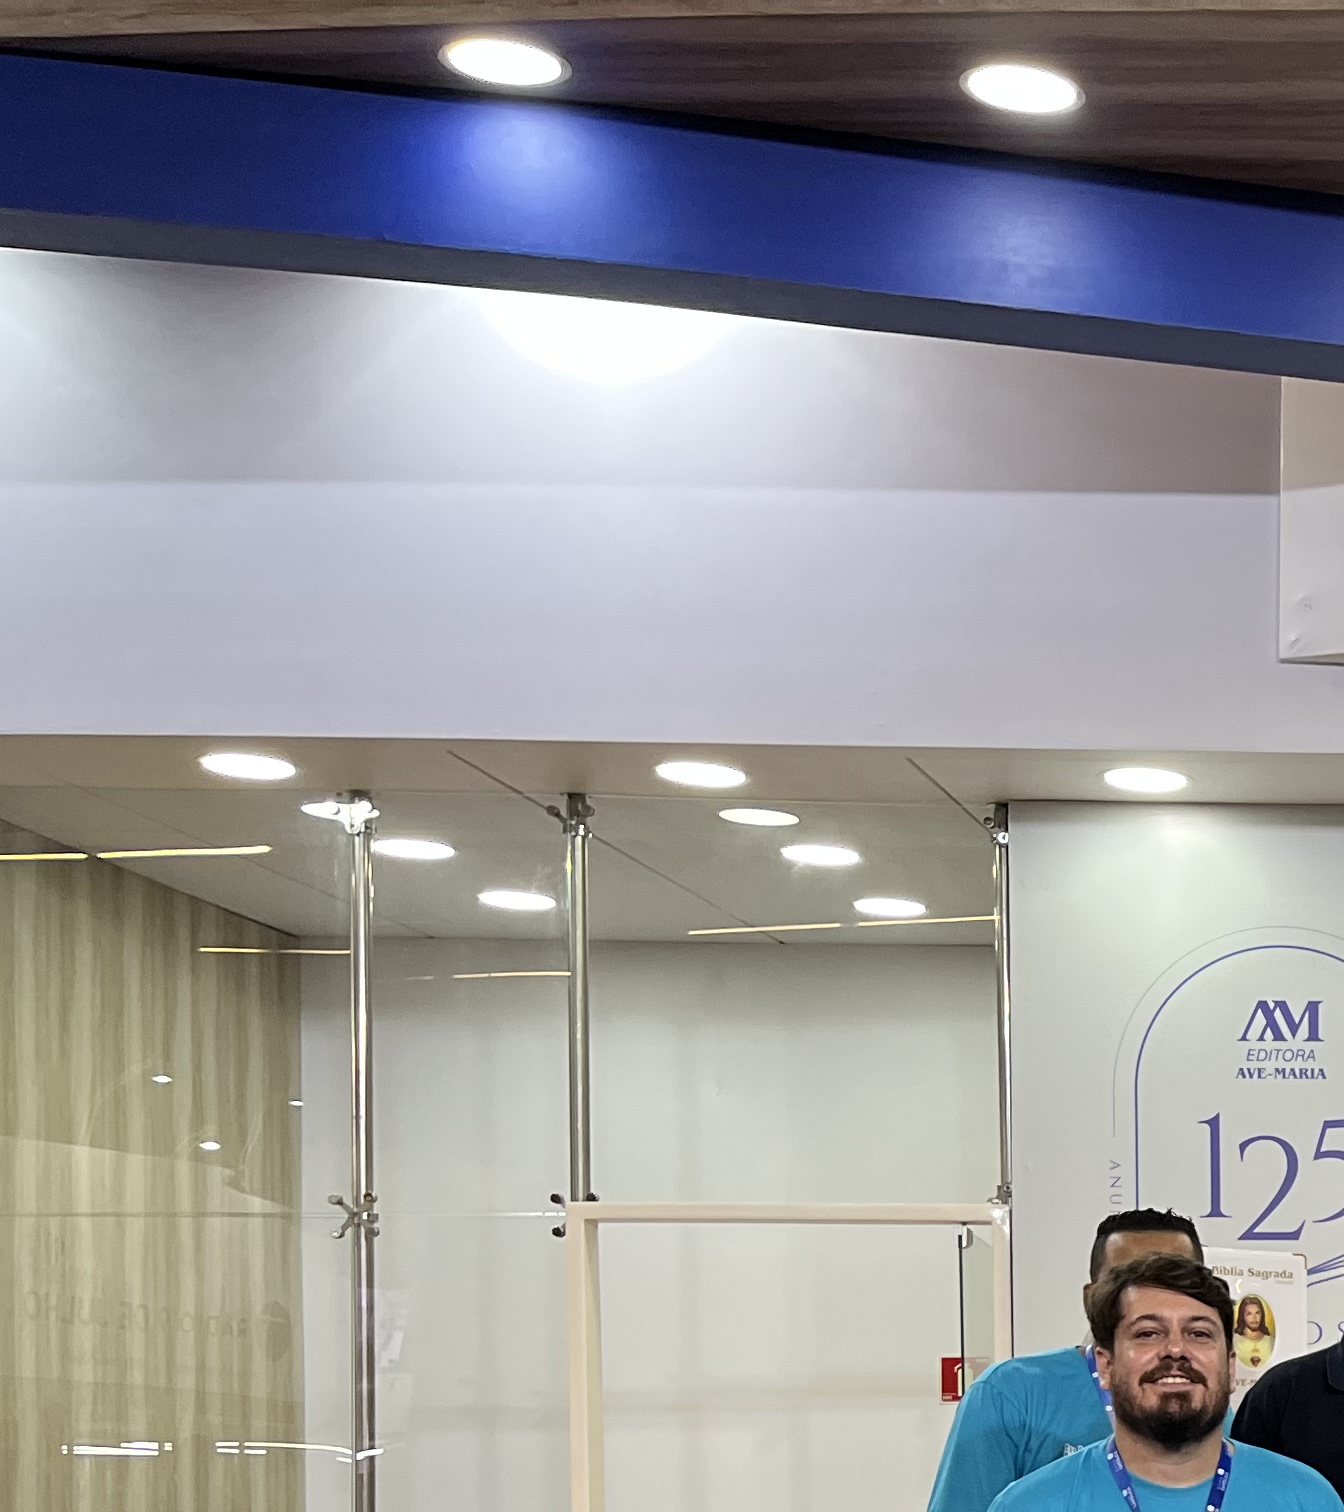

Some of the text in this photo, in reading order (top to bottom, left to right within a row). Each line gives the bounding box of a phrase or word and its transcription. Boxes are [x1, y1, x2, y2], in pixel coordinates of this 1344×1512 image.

[1246, 1049, 1317, 1062] EDITORA
[1235, 1067, 1327, 1080] AVE-MARIA
[1247, 1267, 1294, 1280] Sagrada
